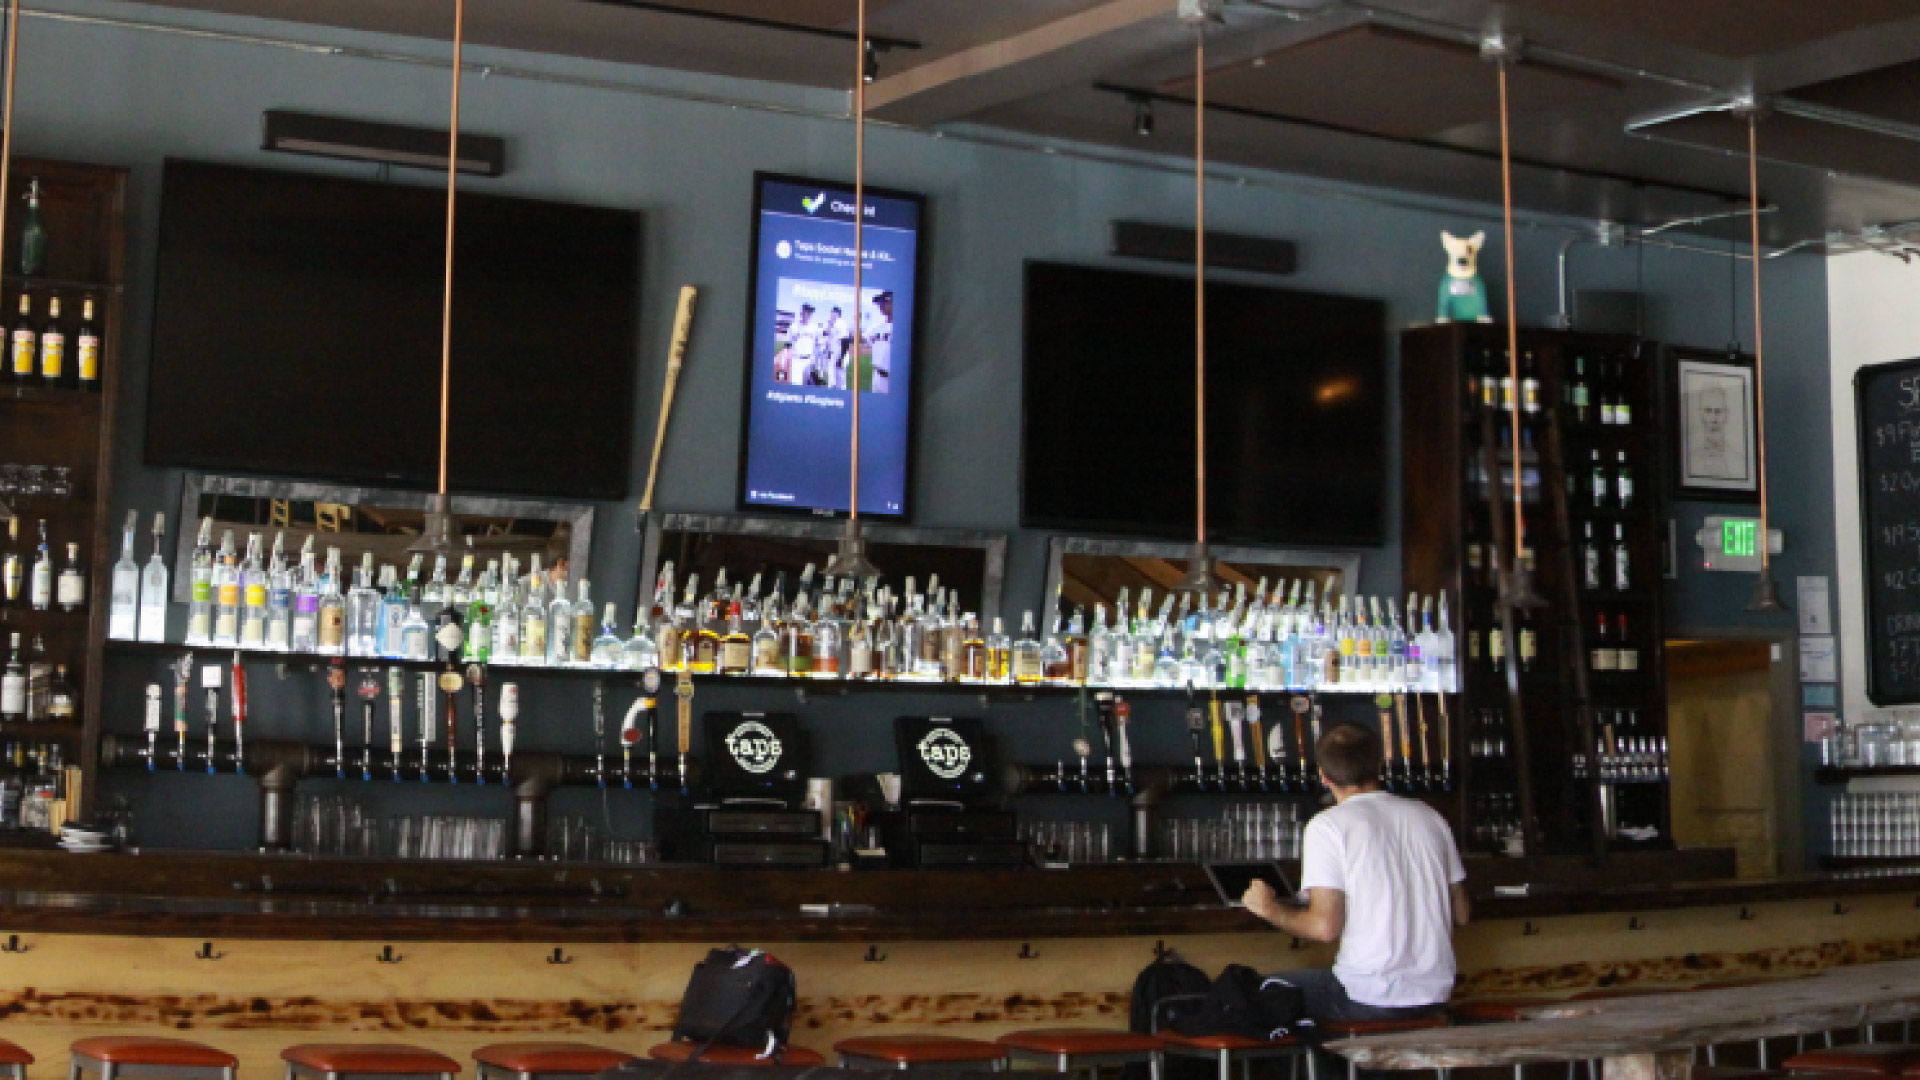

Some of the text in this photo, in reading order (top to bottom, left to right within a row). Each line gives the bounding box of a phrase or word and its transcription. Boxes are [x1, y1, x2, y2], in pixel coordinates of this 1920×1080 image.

[1723, 521, 1756, 556] EXIT
[725, 733, 783, 761] taps
[916, 739, 971, 767] taps
